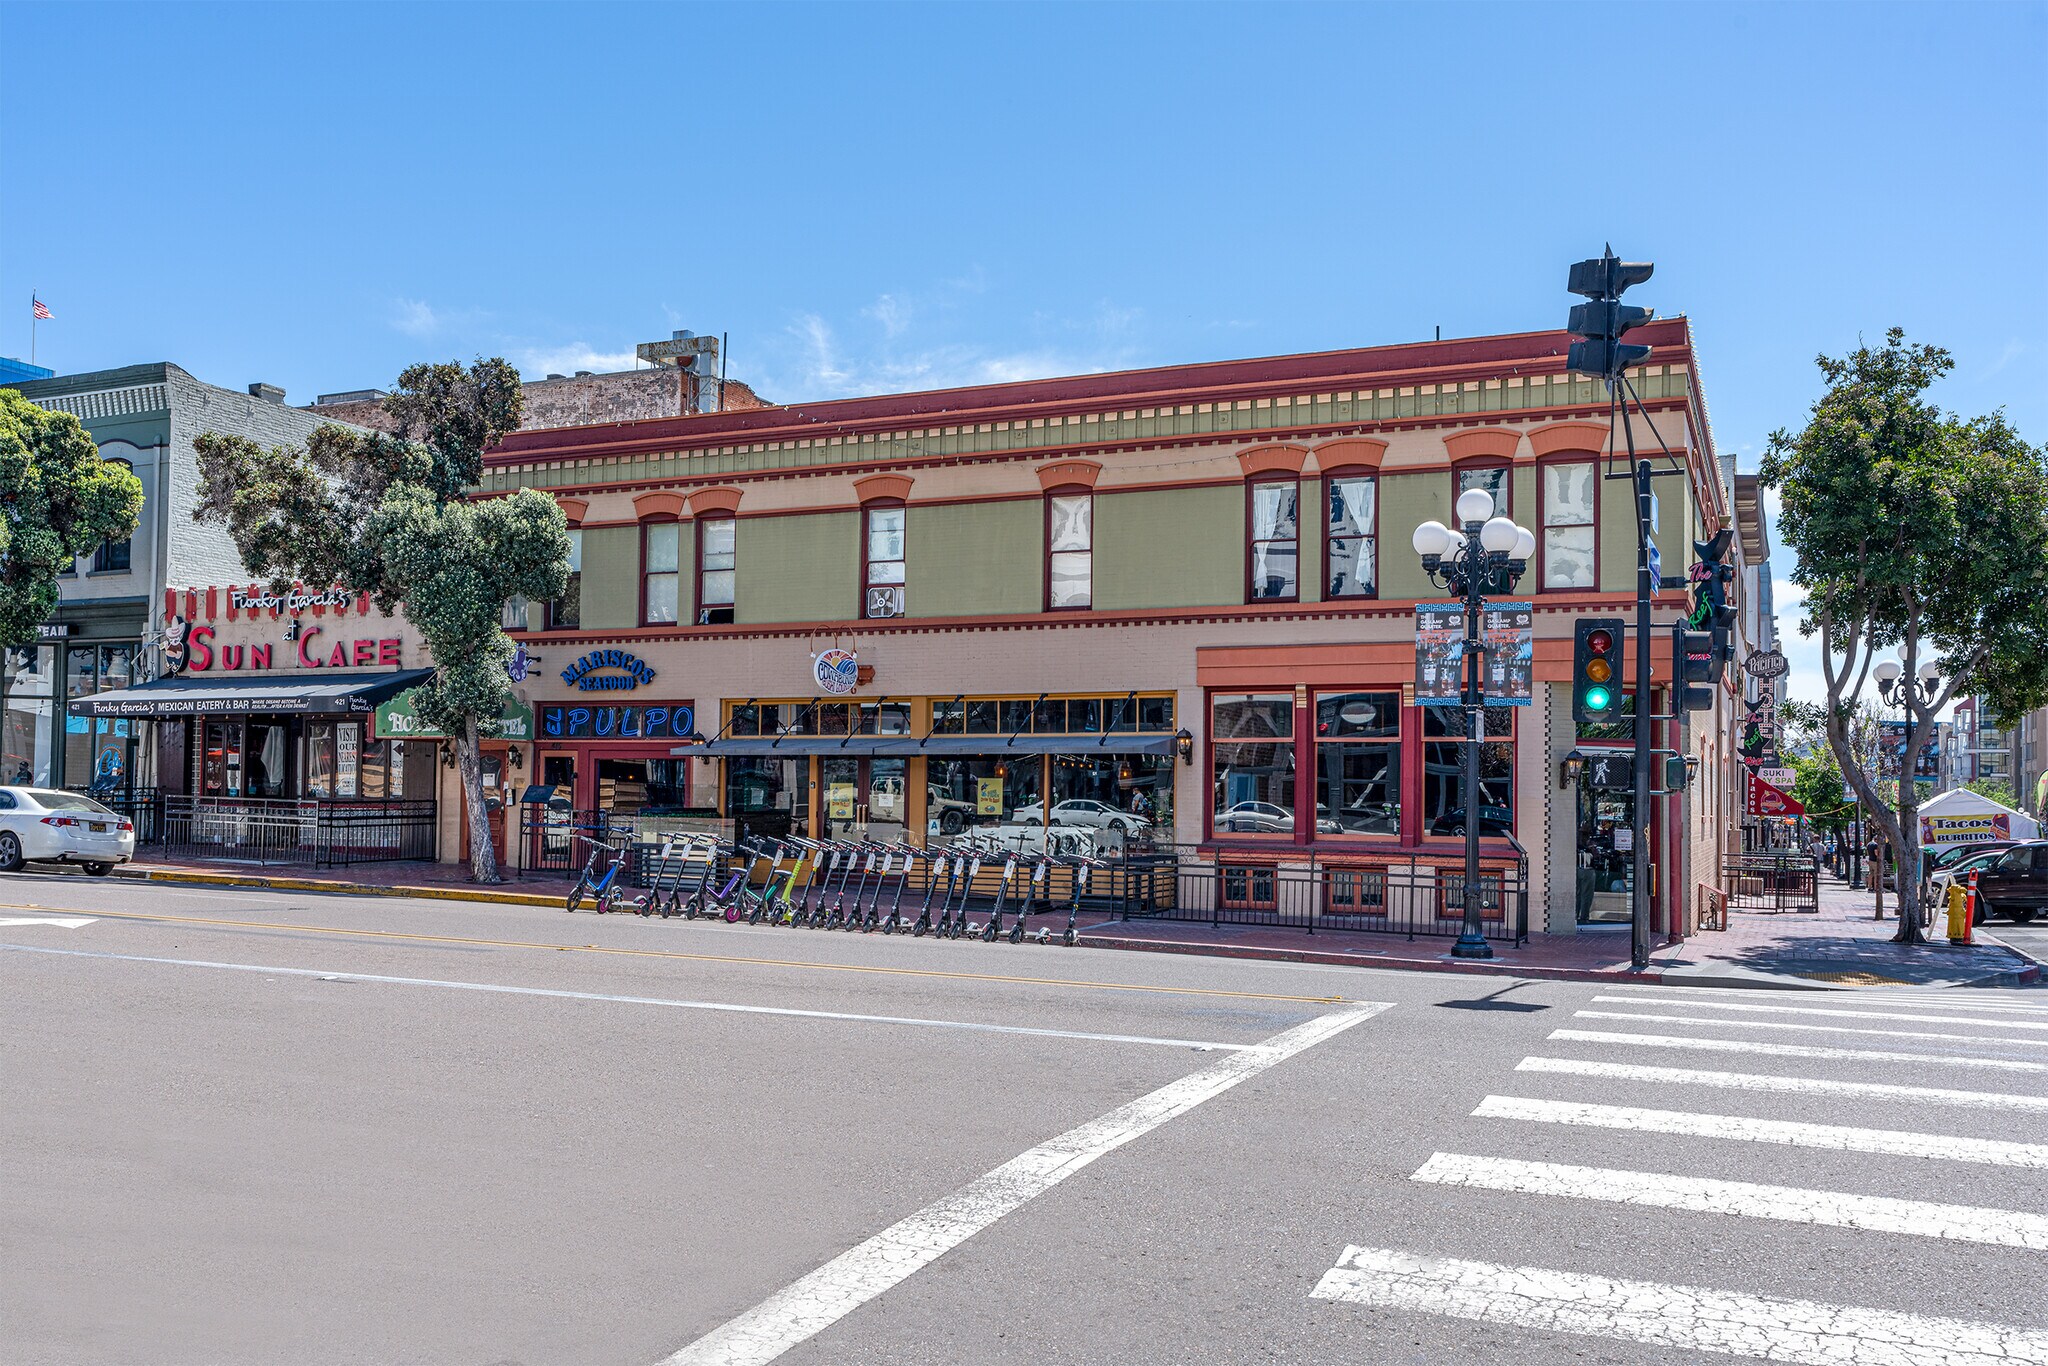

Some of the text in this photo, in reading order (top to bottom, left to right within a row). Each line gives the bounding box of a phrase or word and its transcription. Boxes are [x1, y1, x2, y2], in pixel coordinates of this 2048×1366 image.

[1689, 562, 1712, 582] The
[230, 587, 351, 615] Funky Garcia's
[1688, 591, 1713, 631] Reef
[282, 619, 298, 641] at
[188, 626, 401, 671] SUN CAFE
[560, 650, 656, 687] MARISCOS
[1750, 655, 1785, 672] PACIFICA
[578, 676, 637, 692] SEAFOOD
[93, 702, 119, 716] Funky
[121, 701, 155, 714] Garcia's
[158, 701, 194, 712] MEXICAN
[196, 700, 225, 711] EATERY
[225, 700, 232, 709] &
[233, 700, 250, 709] BAR
[334, 698, 345, 706] 421
[568, 707, 693, 736] PULPO
[338, 728, 357, 742] VISIT
[339, 743, 357, 751] OUR
[930, 821, 938, 831] A
[1934, 819, 1993, 829] Tacos
[1937, 832, 1996, 842] BURRITOS
